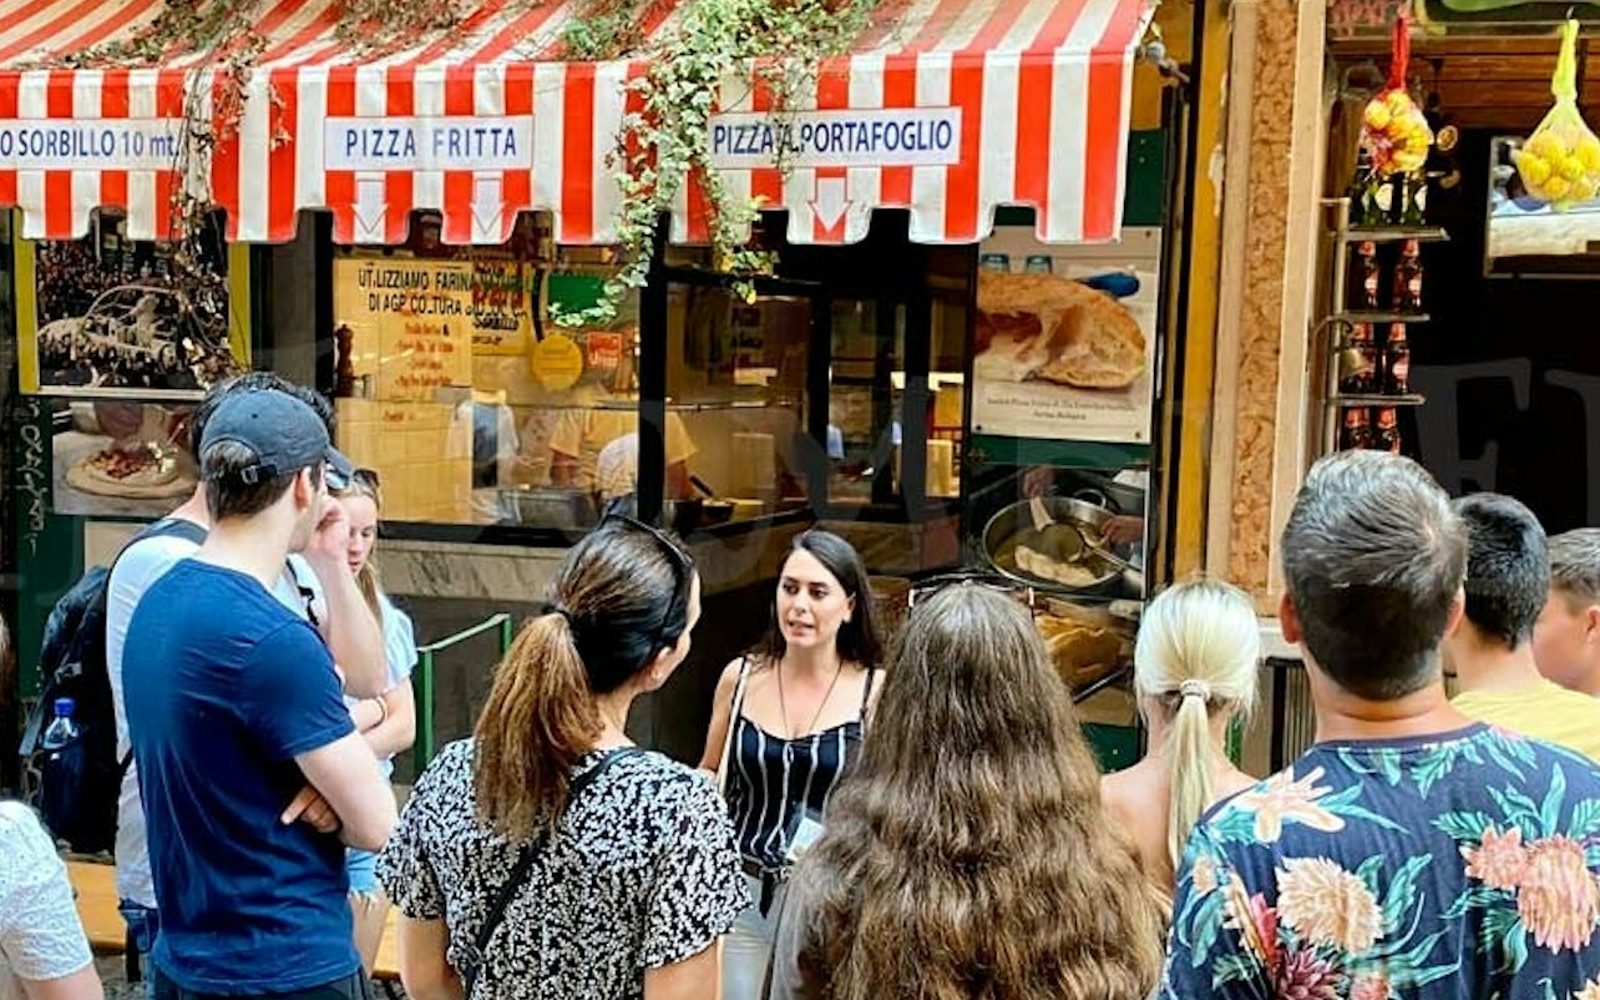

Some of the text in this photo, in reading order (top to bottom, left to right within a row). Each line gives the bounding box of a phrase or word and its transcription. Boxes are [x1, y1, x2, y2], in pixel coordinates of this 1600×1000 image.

[0, 130, 13, 157] O
[18, 129, 116, 157] SORBILLO
[122, 131, 144, 157] 10
[346, 127, 517, 158] PIZZA FRITTA
[713, 124, 774, 155] PIZZA
[801, 119, 953, 153] PORTAFOGLIO
[368, 293, 381, 313] DI
